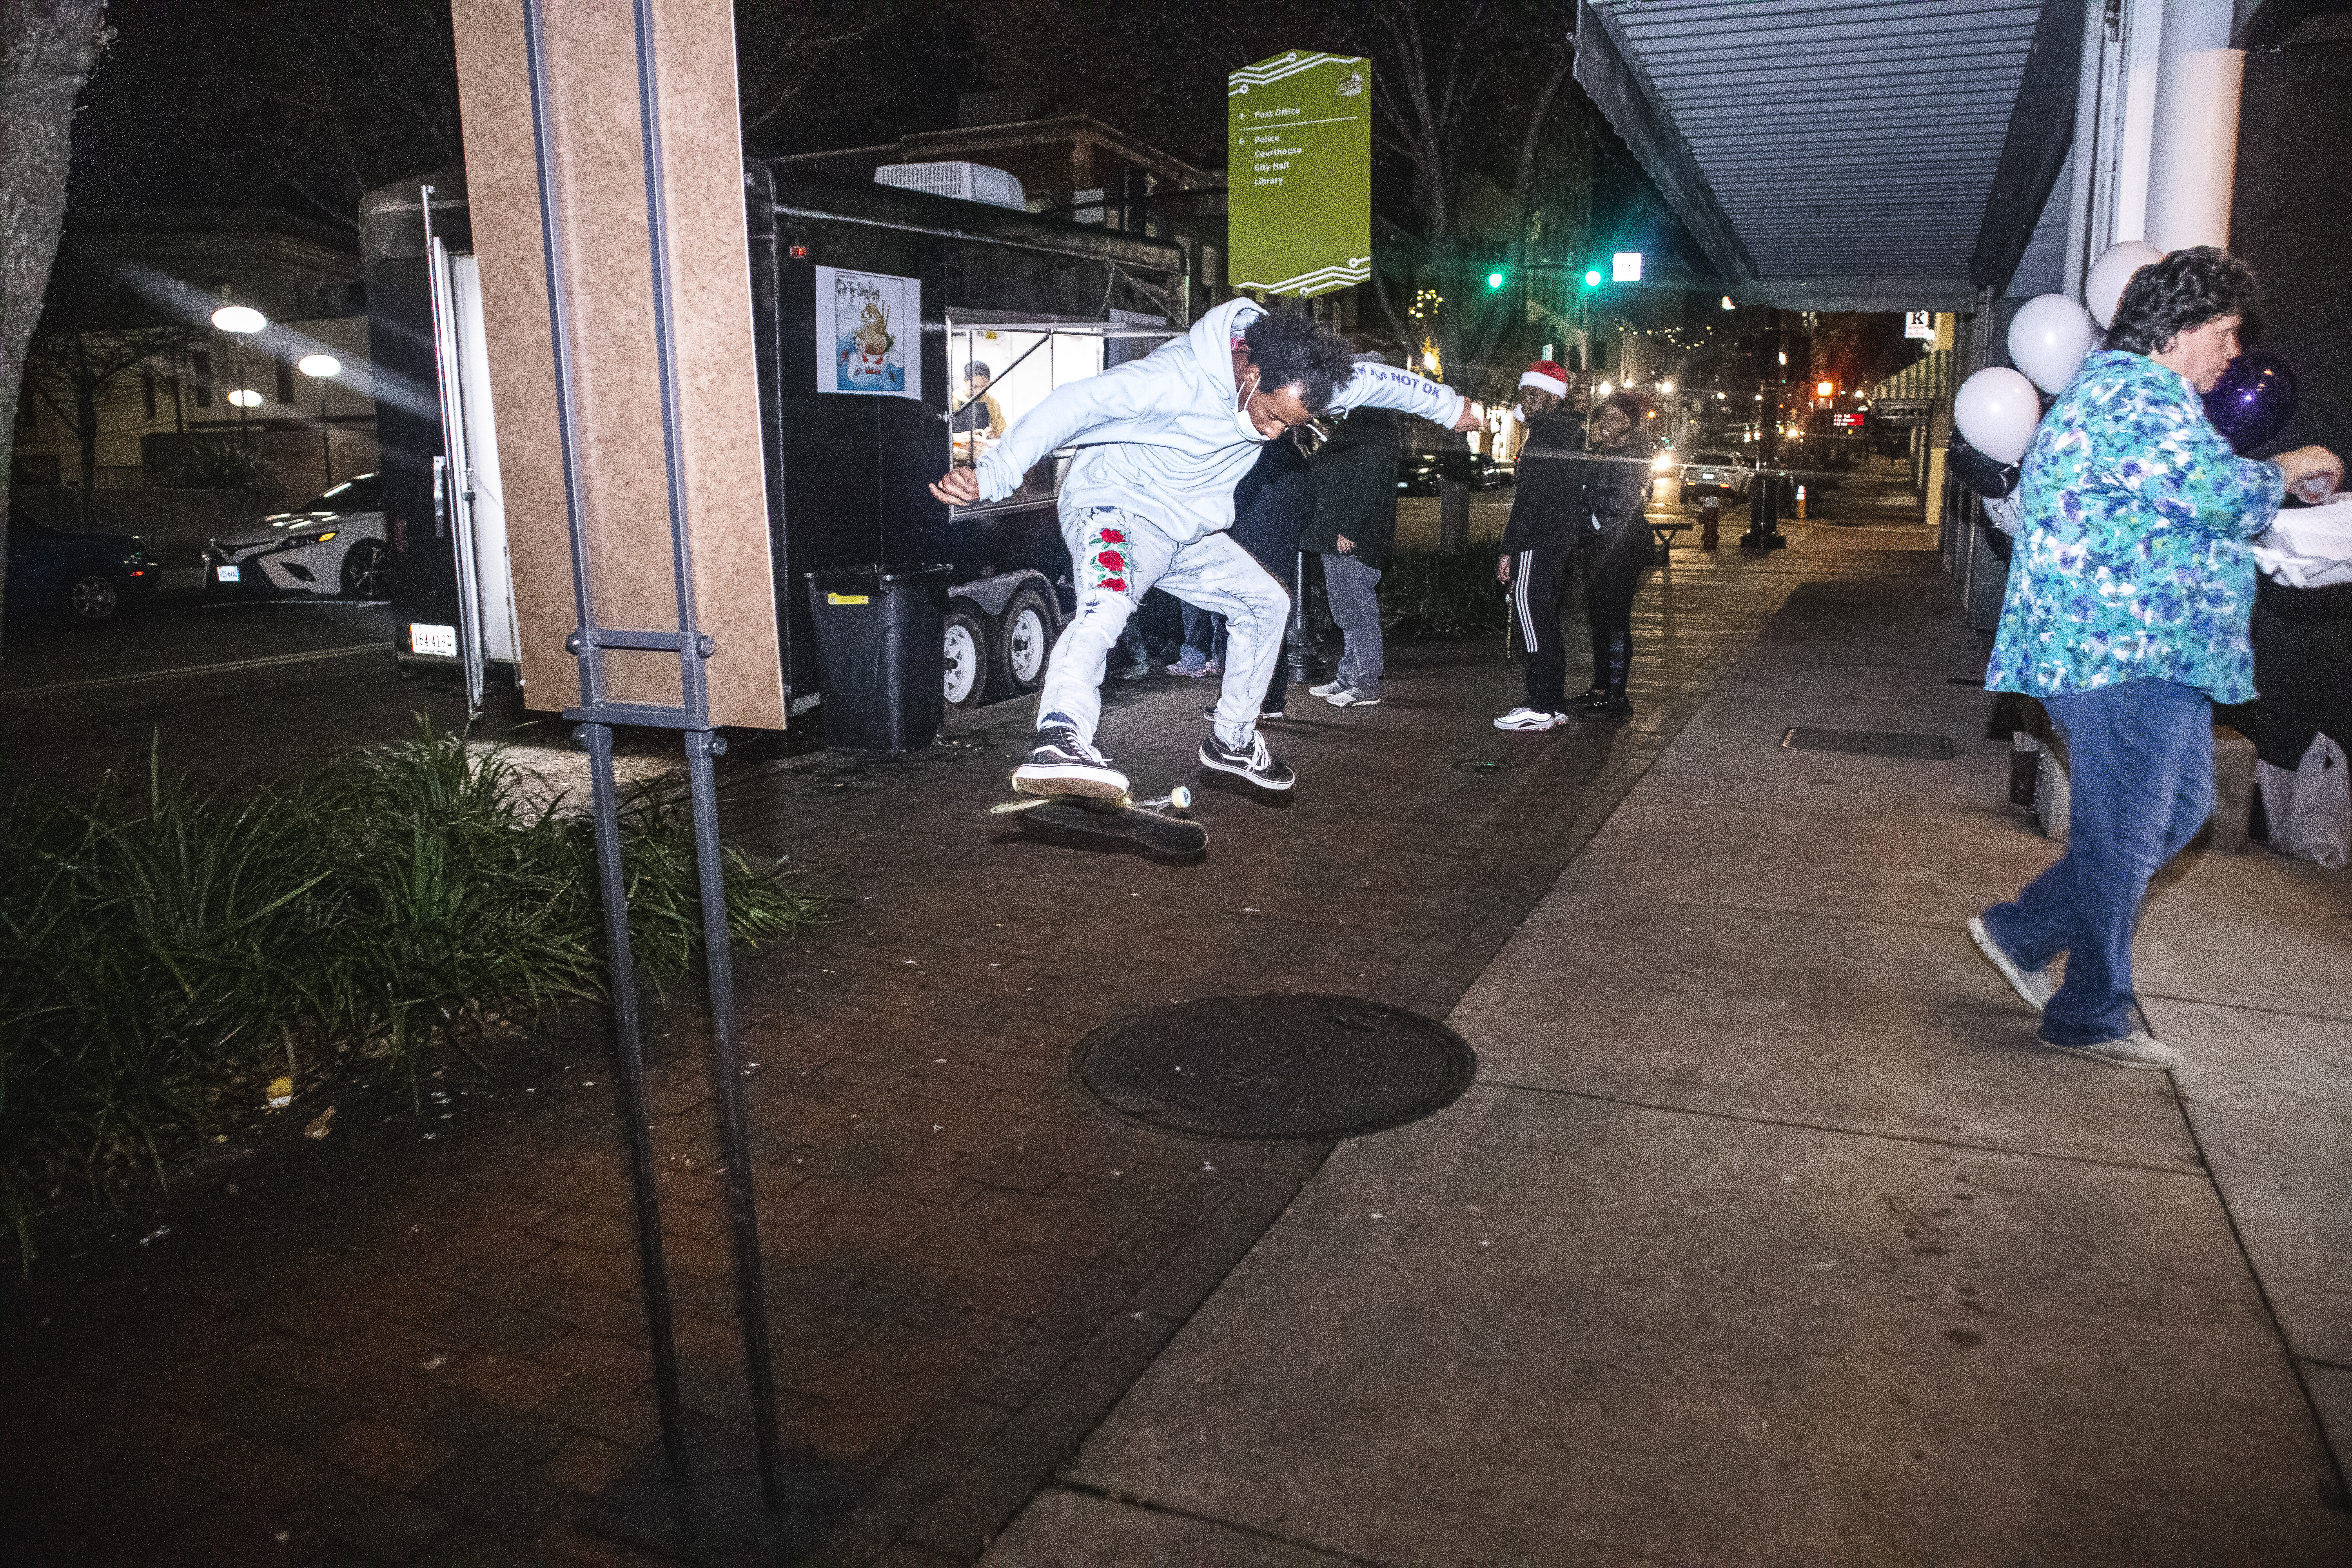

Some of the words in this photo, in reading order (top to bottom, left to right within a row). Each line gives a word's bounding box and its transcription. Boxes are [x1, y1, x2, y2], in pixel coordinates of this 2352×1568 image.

[1254, 110, 1272, 119] Post
[1275, 107, 1300, 116] Office
[1254, 135, 1279, 143] Police
[1254, 147, 1302, 158] Courthouse
[1254, 163, 1270, 172] City
[1273, 161, 1289, 169] Hall
[1254, 177, 1283, 185] Library
[1391, 372, 1419, 388] NOT
[1423, 383, 1441, 399] OK
